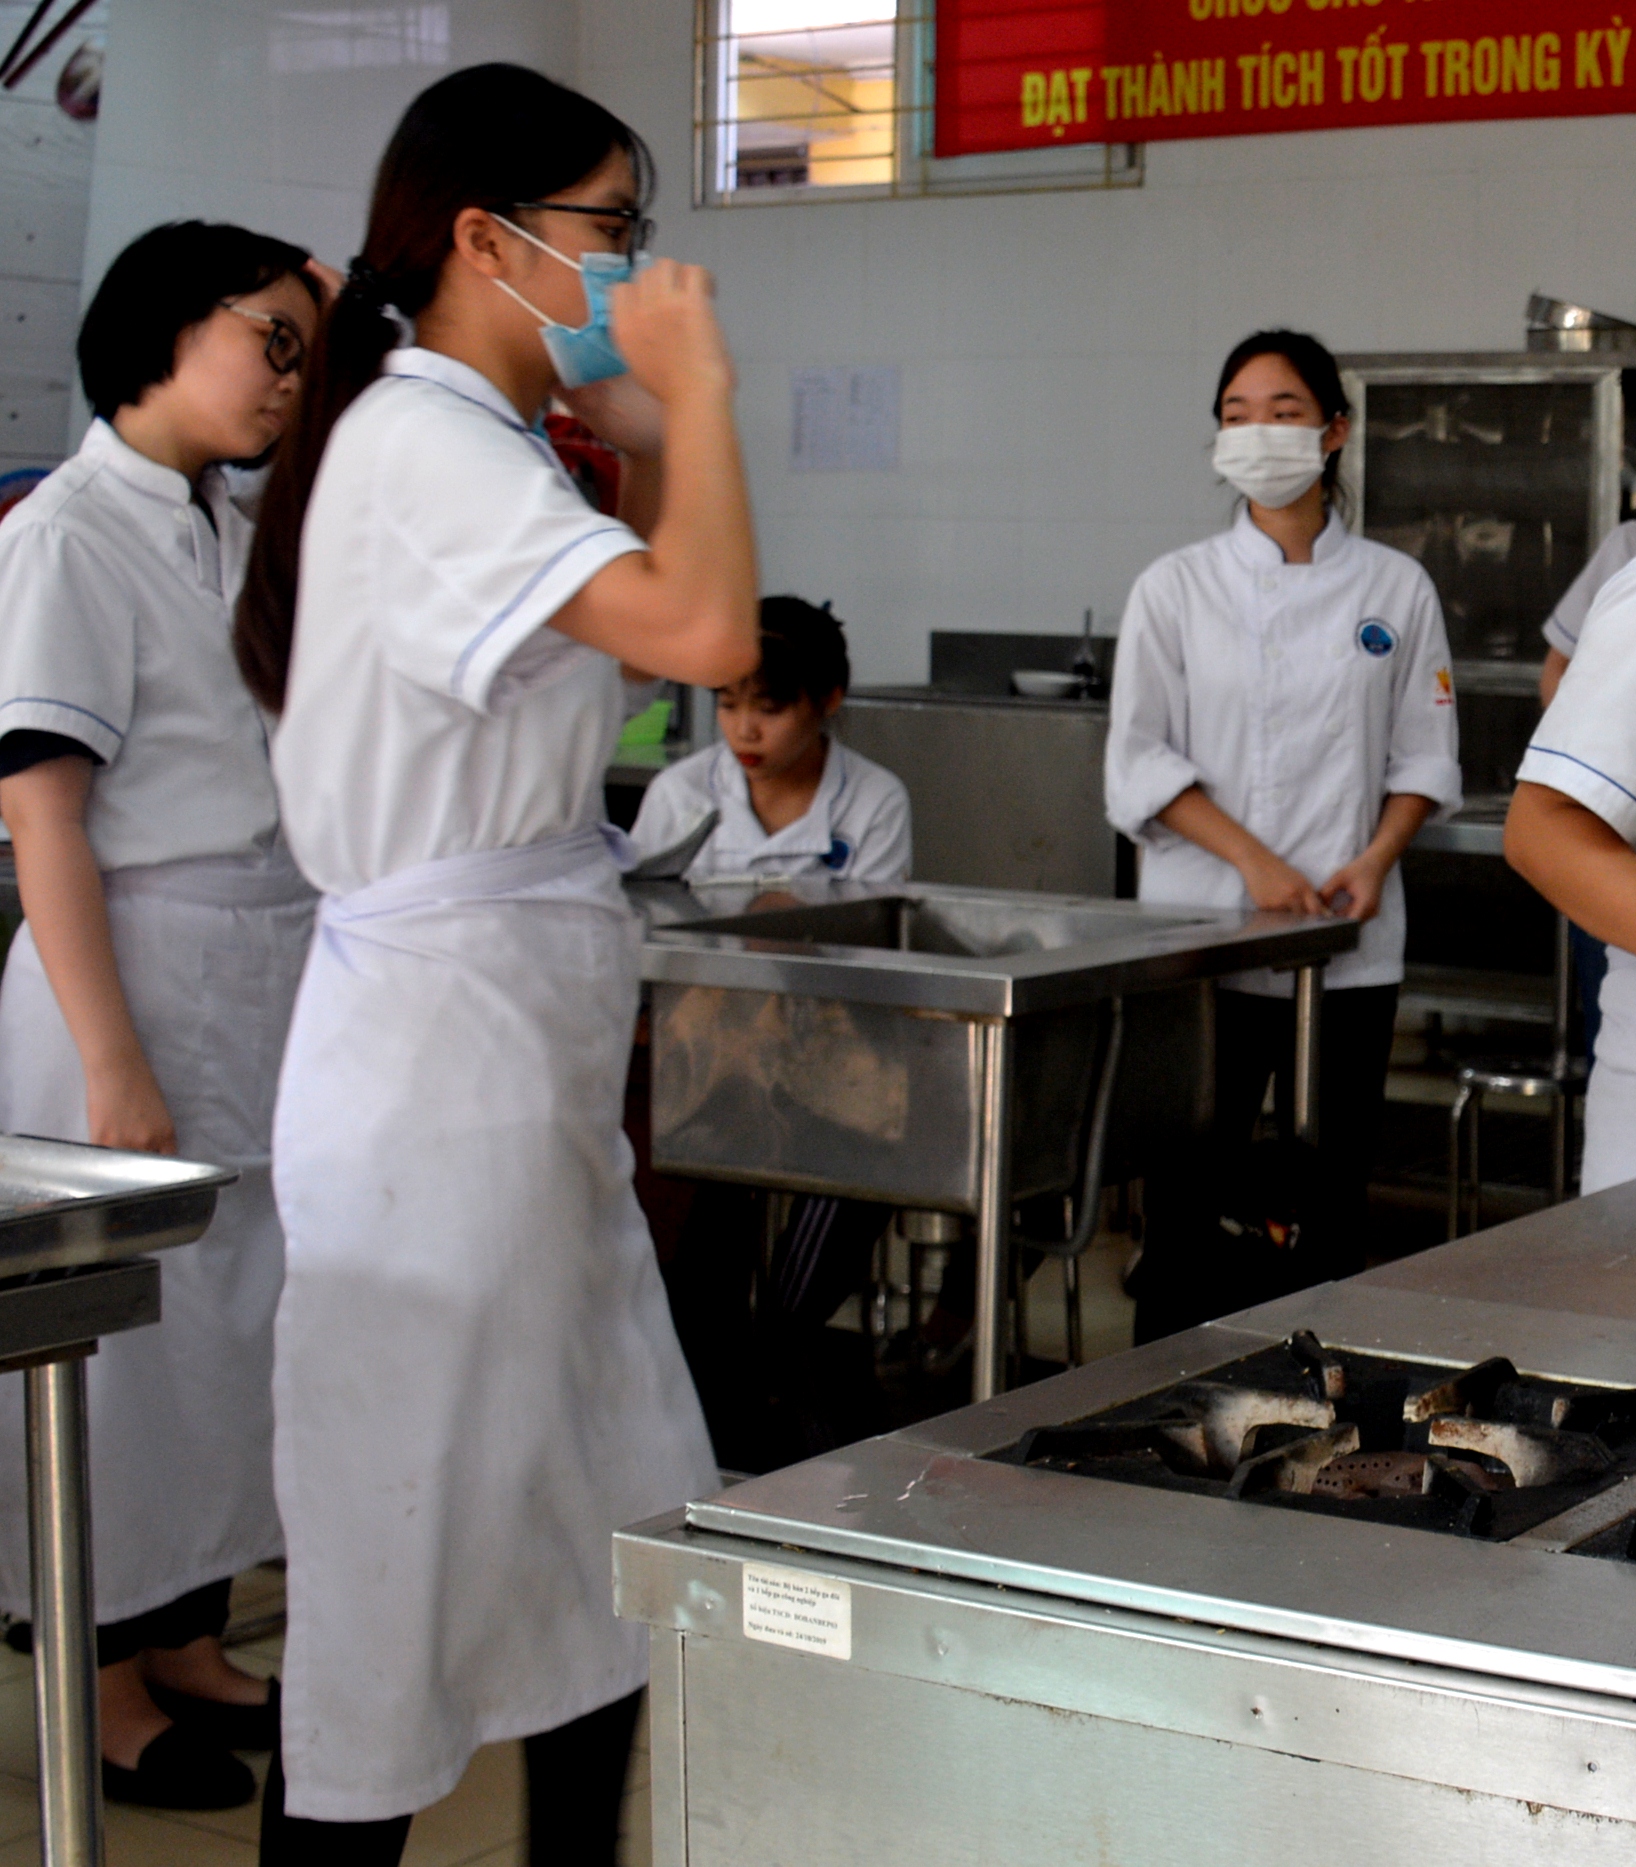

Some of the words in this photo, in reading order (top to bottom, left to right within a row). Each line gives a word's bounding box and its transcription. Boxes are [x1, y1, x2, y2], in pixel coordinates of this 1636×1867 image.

[1021, 68, 1093, 137] ĐẠT
[1100, 50, 1226, 119] THÀNH
[1236, 41, 1325, 110] TÍCH
[1336, 24, 1409, 102] TỐT
[1420, 32, 1561, 98] TRONG
[1575, 15, 1631, 89] KỲ
